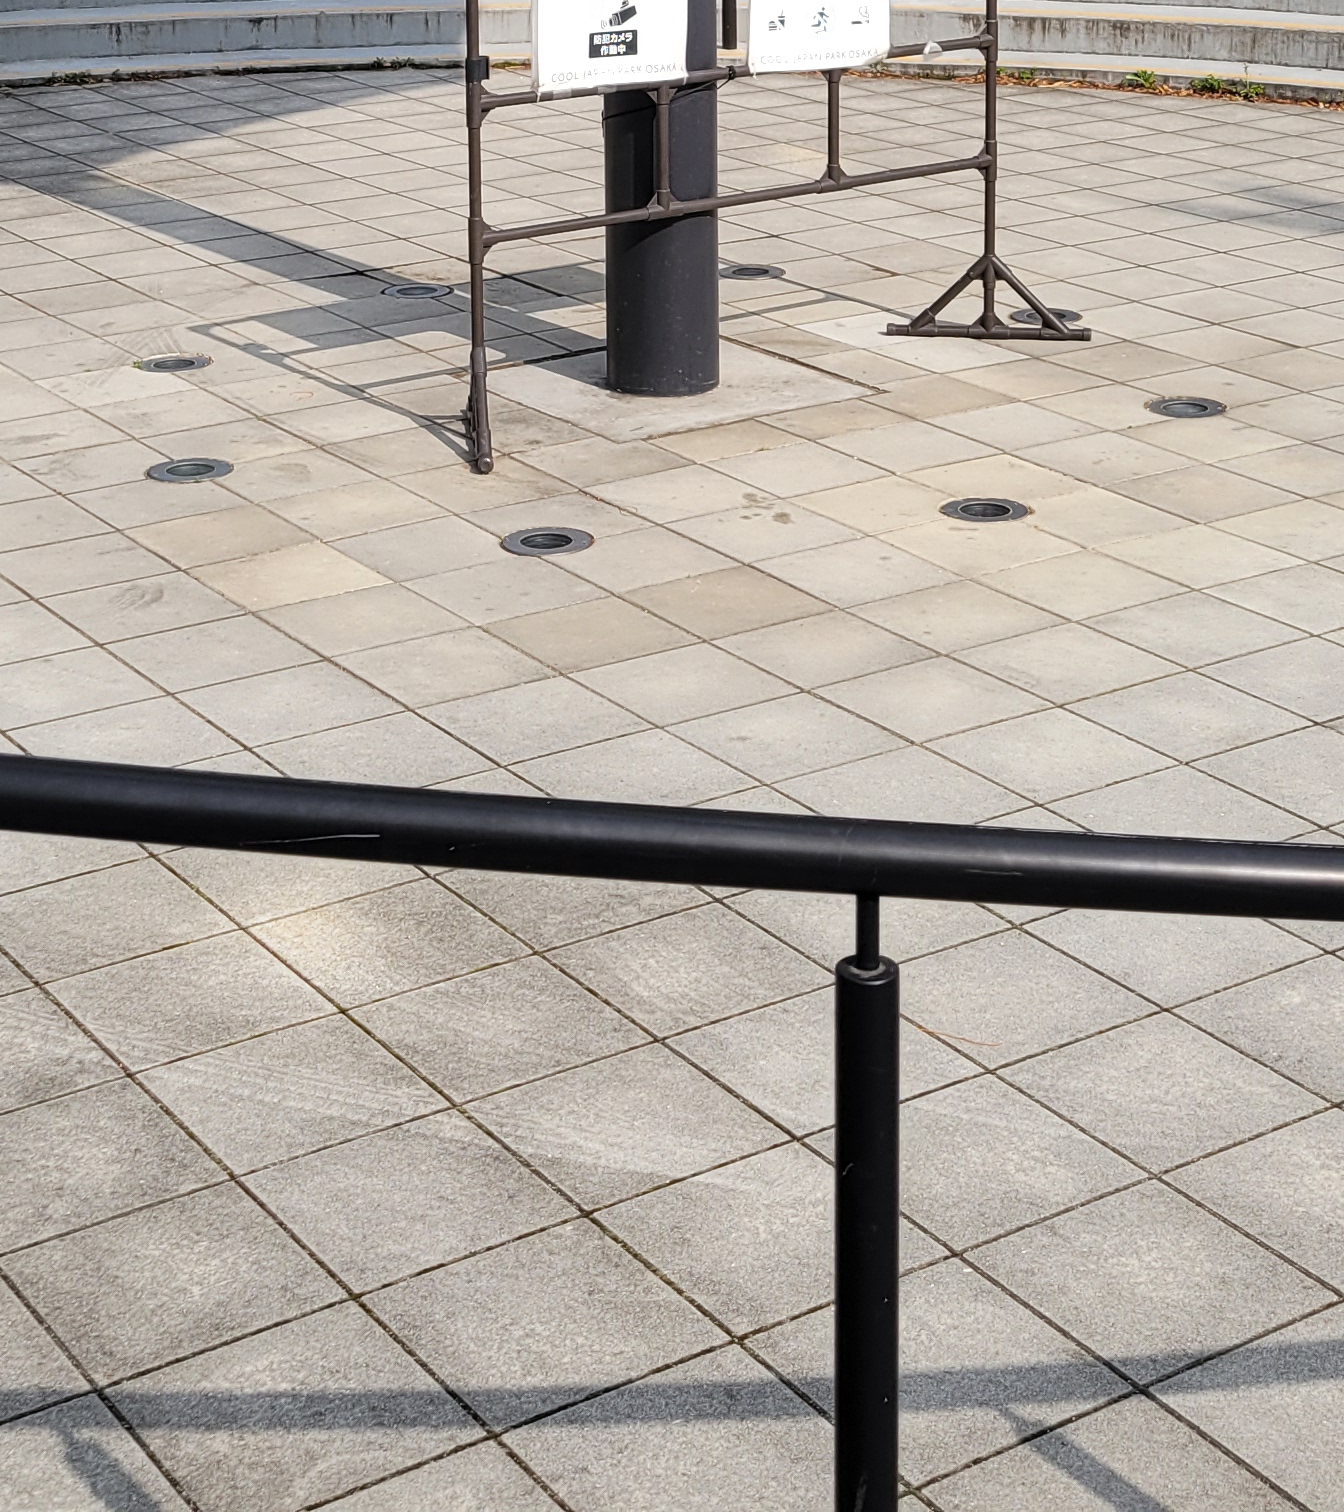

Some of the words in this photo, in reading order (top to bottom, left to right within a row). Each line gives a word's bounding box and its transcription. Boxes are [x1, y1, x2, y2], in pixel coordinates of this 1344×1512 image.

[593, 32, 634, 45] 防犯カメラ
[825, 50, 847, 61] PARK
[849, 49, 879, 59] OSAKA
[551, 72, 579, 83] COOL
[646, 63, 677, 74] OSAKA
